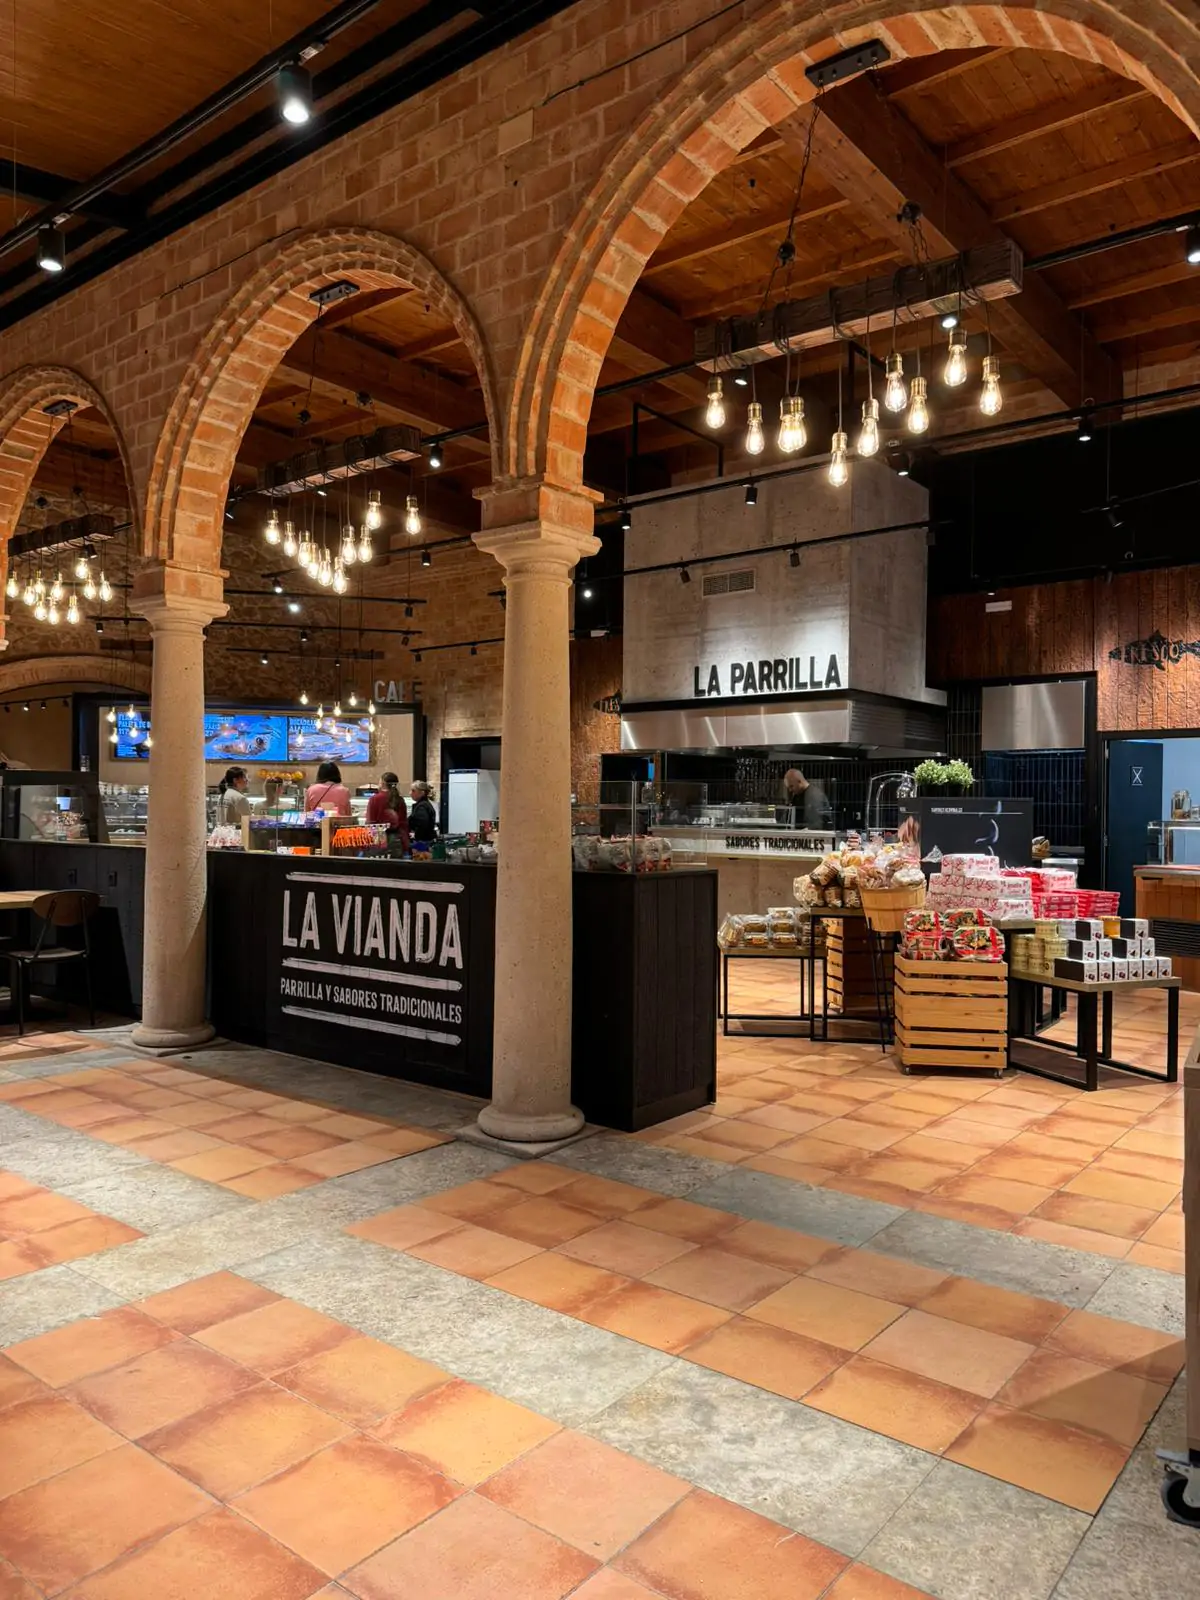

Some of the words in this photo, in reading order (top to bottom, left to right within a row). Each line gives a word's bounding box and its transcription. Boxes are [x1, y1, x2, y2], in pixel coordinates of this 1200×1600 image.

[694, 665, 721, 697] LA
[730, 653, 842, 693] PARRILLA
[725, 835, 760, 850] SABORES
[763, 837, 825, 851] TRADICIONALES
[282, 889, 320, 950] LA
[331, 893, 463, 969] VIANDA
[280, 977, 323, 1001] PARRILLA
[325, 984, 332, 1002] Y
[333, 987, 378, 1010] SABORES
[379, 993, 463, 1025] TRADICIONALES
